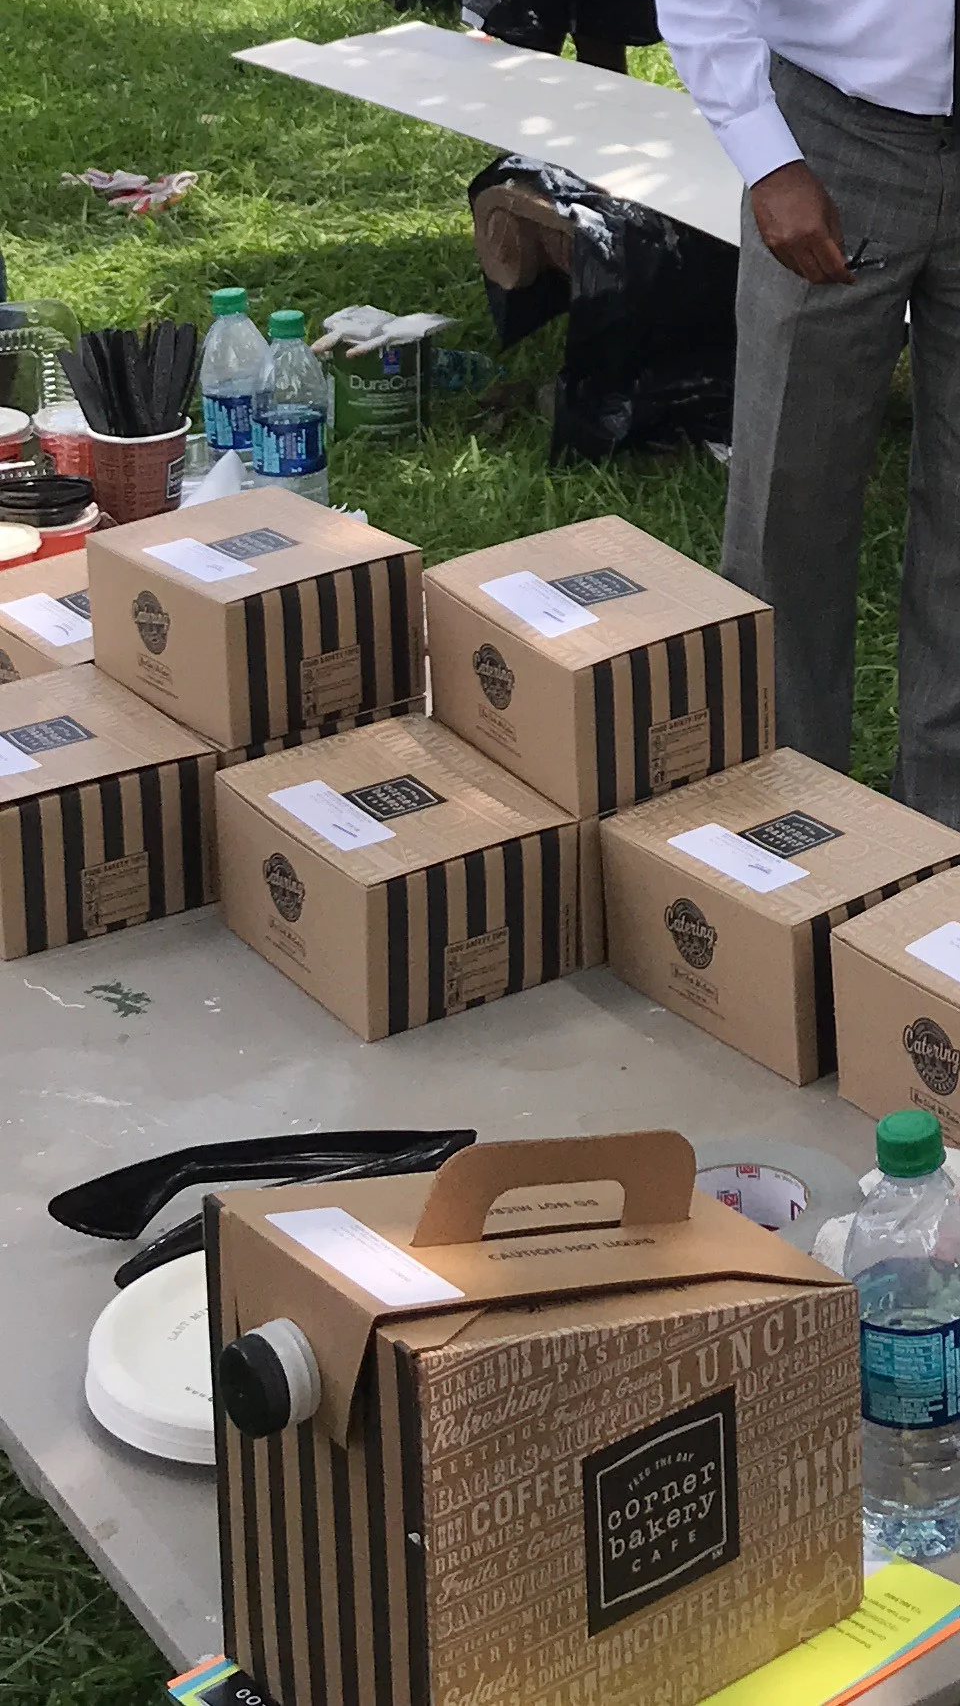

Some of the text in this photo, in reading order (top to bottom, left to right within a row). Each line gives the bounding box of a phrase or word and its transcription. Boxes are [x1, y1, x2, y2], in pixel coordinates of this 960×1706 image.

[665, 906, 716, 949] Catering
[904, 1027, 960, 1074] Catering
[487, 1237, 656, 1261] CAUTION HOT LIQUID
[430, 1358, 494, 1403] LUNCH
[557, 1314, 684, 1383] PASTRIE
[668, 1293, 819, 1406] LUNCH
[432, 1381, 554, 1454] Refreshing
[432, 1418, 546, 1483] MEETINGS
[433, 1444, 539, 1519] BAGELS
[655, 1455, 672, 1470] THE
[675, 1452, 696, 1463] DAY
[778, 1430, 862, 1527] FRESH
[607, 1461, 715, 1531] corner
[609, 1490, 717, 1561] bakery
[435, 1518, 524, 1575] BROWNIES
[436, 1559, 498, 1605] Fruits
[506, 1548, 520, 1571] &
[631, 1530, 697, 1573] CAFE
[634, 1579, 731, 1654] COFFEE
